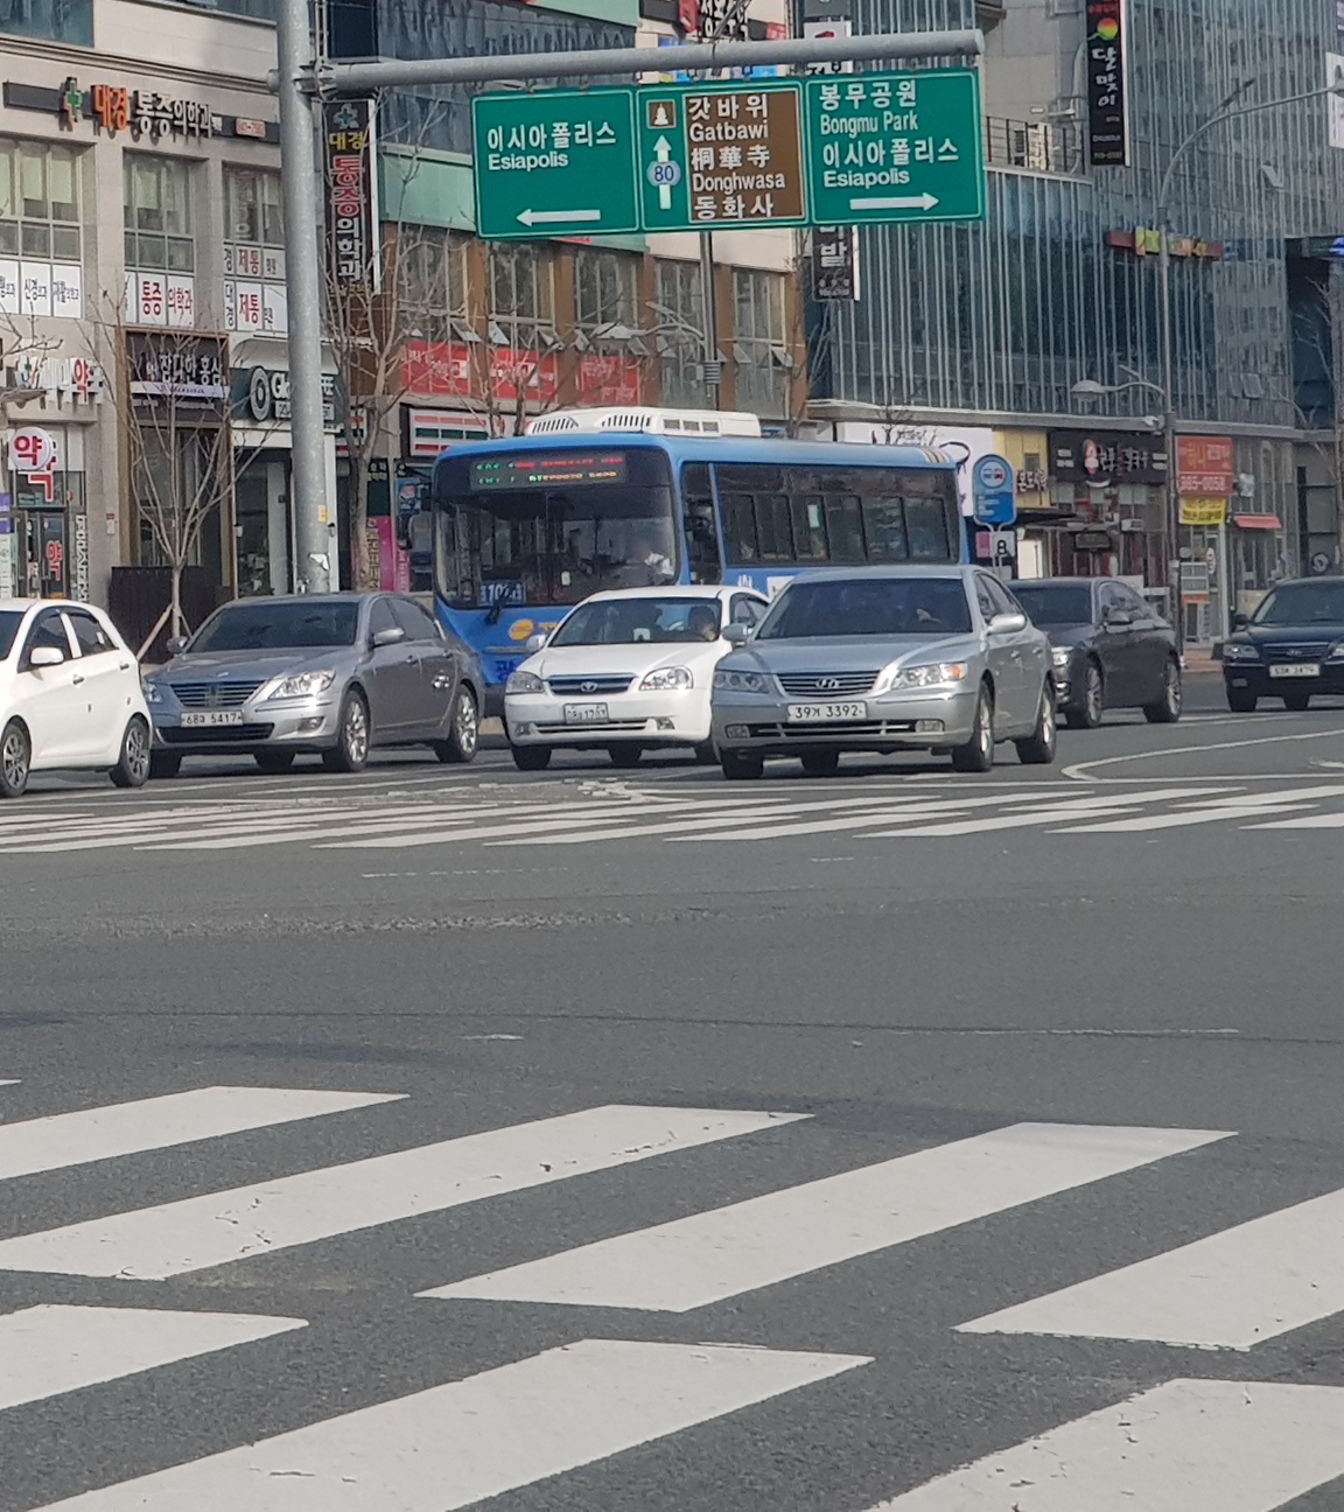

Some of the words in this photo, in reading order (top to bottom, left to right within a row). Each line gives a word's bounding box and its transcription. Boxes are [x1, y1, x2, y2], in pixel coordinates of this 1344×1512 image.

[92, 85, 129, 132] 대경
[688, 94, 769, 122] 갓바위
[819, 79, 918, 111] 봉무공원
[488, 121, 618, 152] 이시아폴리스
[689, 120, 770, 142] Gatbawi
[820, 112, 880, 137] Bongmu
[883, 109, 920, 134] Park
[329, 130, 366, 152] 대경
[823, 137, 960, 168] 이시아폴리스
[488, 151, 570, 172] Esiapolis
[691, 145, 772, 172] 桐華寺
[330, 154, 366, 218] 통증
[654, 165, 675, 184] 80
[692, 169, 786, 194] Donghwasa
[824, 167, 911, 190] Esiapolis
[694, 194, 775, 221] 동화사
[337, 217, 364, 283] 의학과
[142, 280, 163, 316] 통증
[168, 287, 193, 315] 의학과
[200, 355, 224, 387] 홍삼
[13, 434, 43, 467] 약
[210, 712, 238, 725] 5417
[825, 704, 859, 719] 3392
